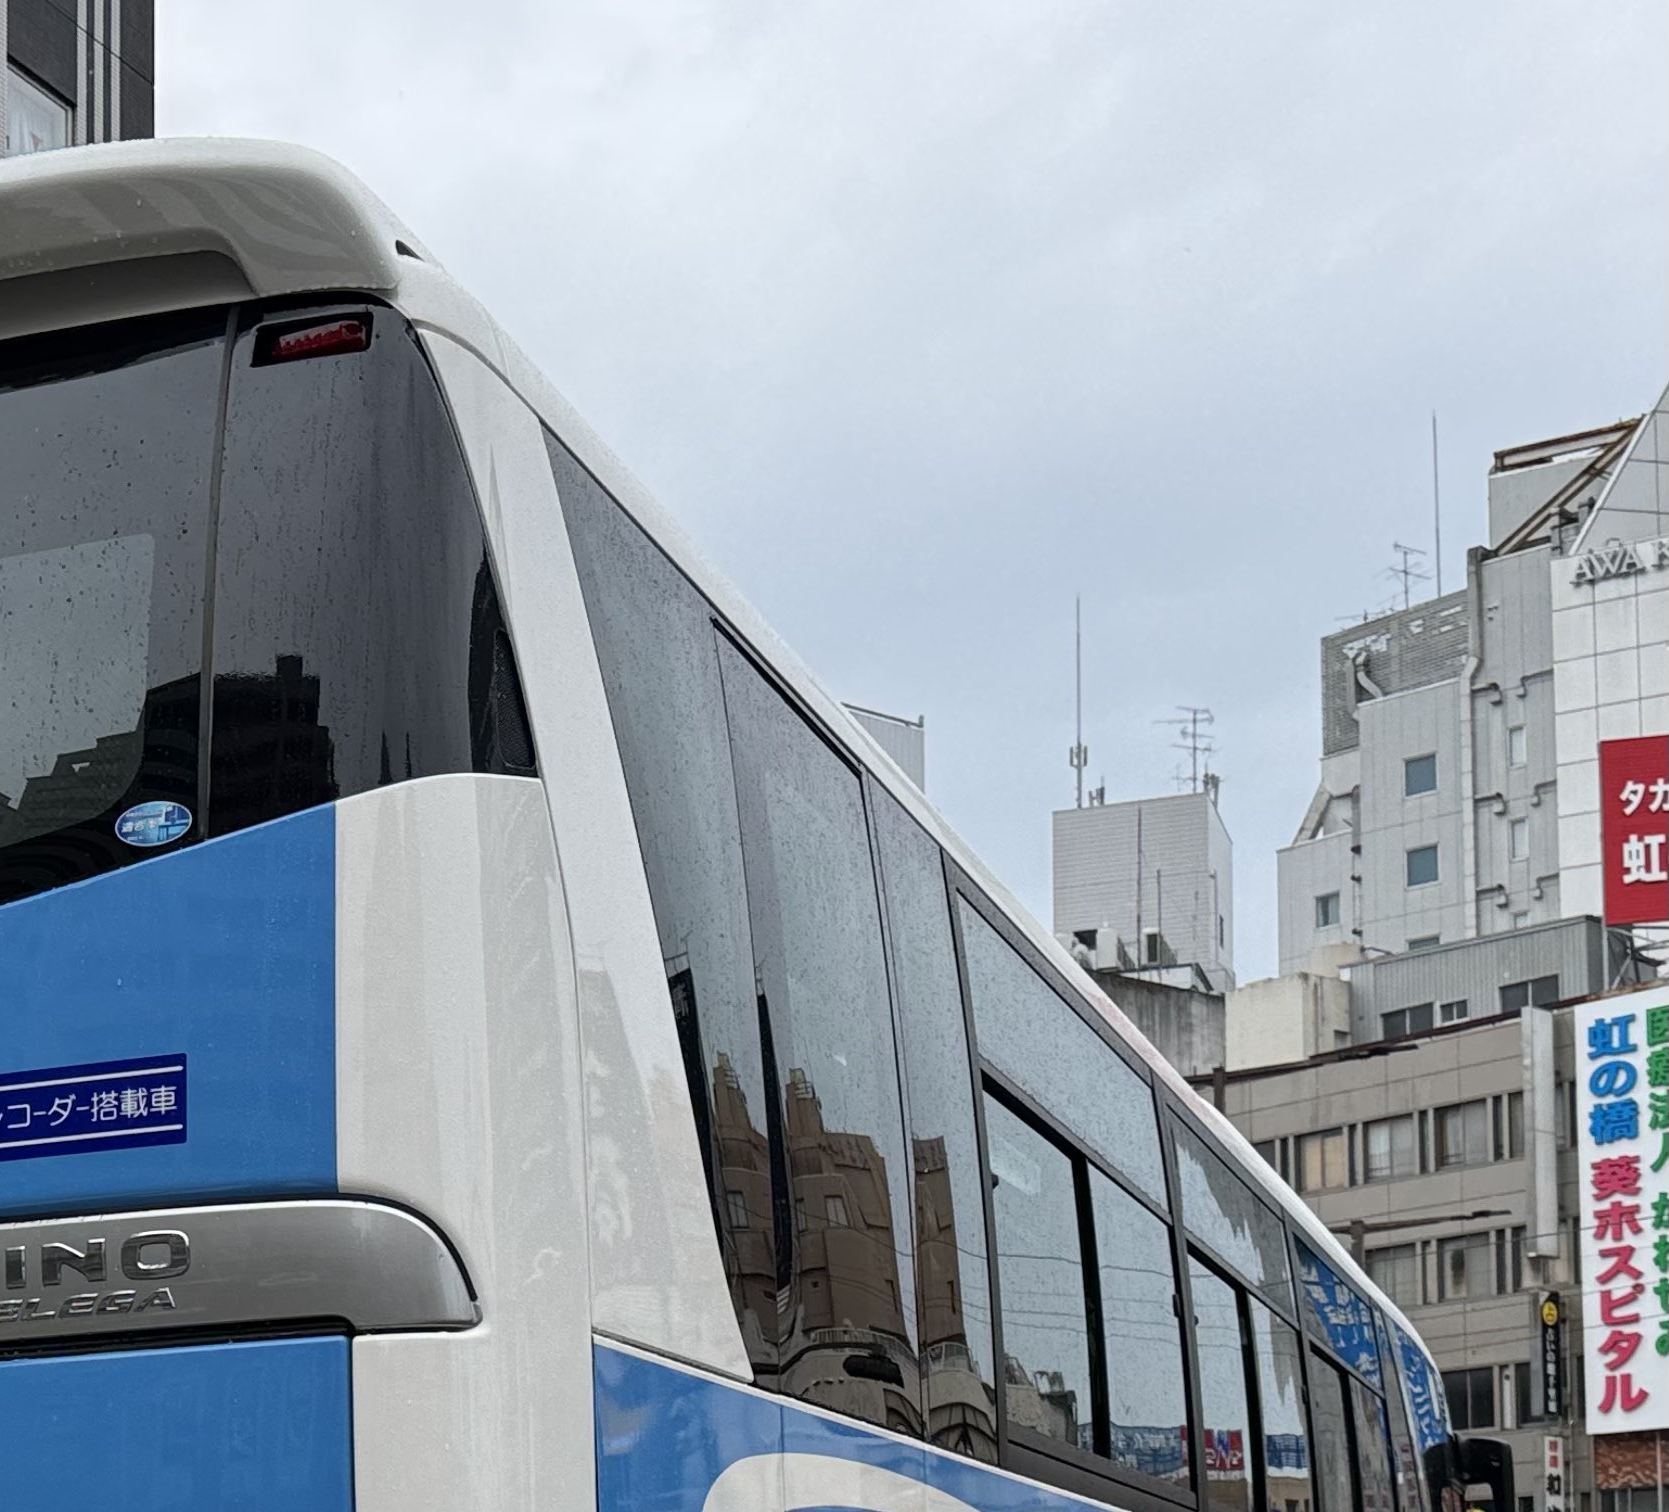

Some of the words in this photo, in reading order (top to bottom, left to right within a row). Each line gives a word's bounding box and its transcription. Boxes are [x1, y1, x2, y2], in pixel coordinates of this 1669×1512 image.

[1622, 833, 1668, 884] 虹
[1587, 1013, 1640, 1146] 虹の橋
[1590, 1155, 1650, 1414] 葵ホスピタル
